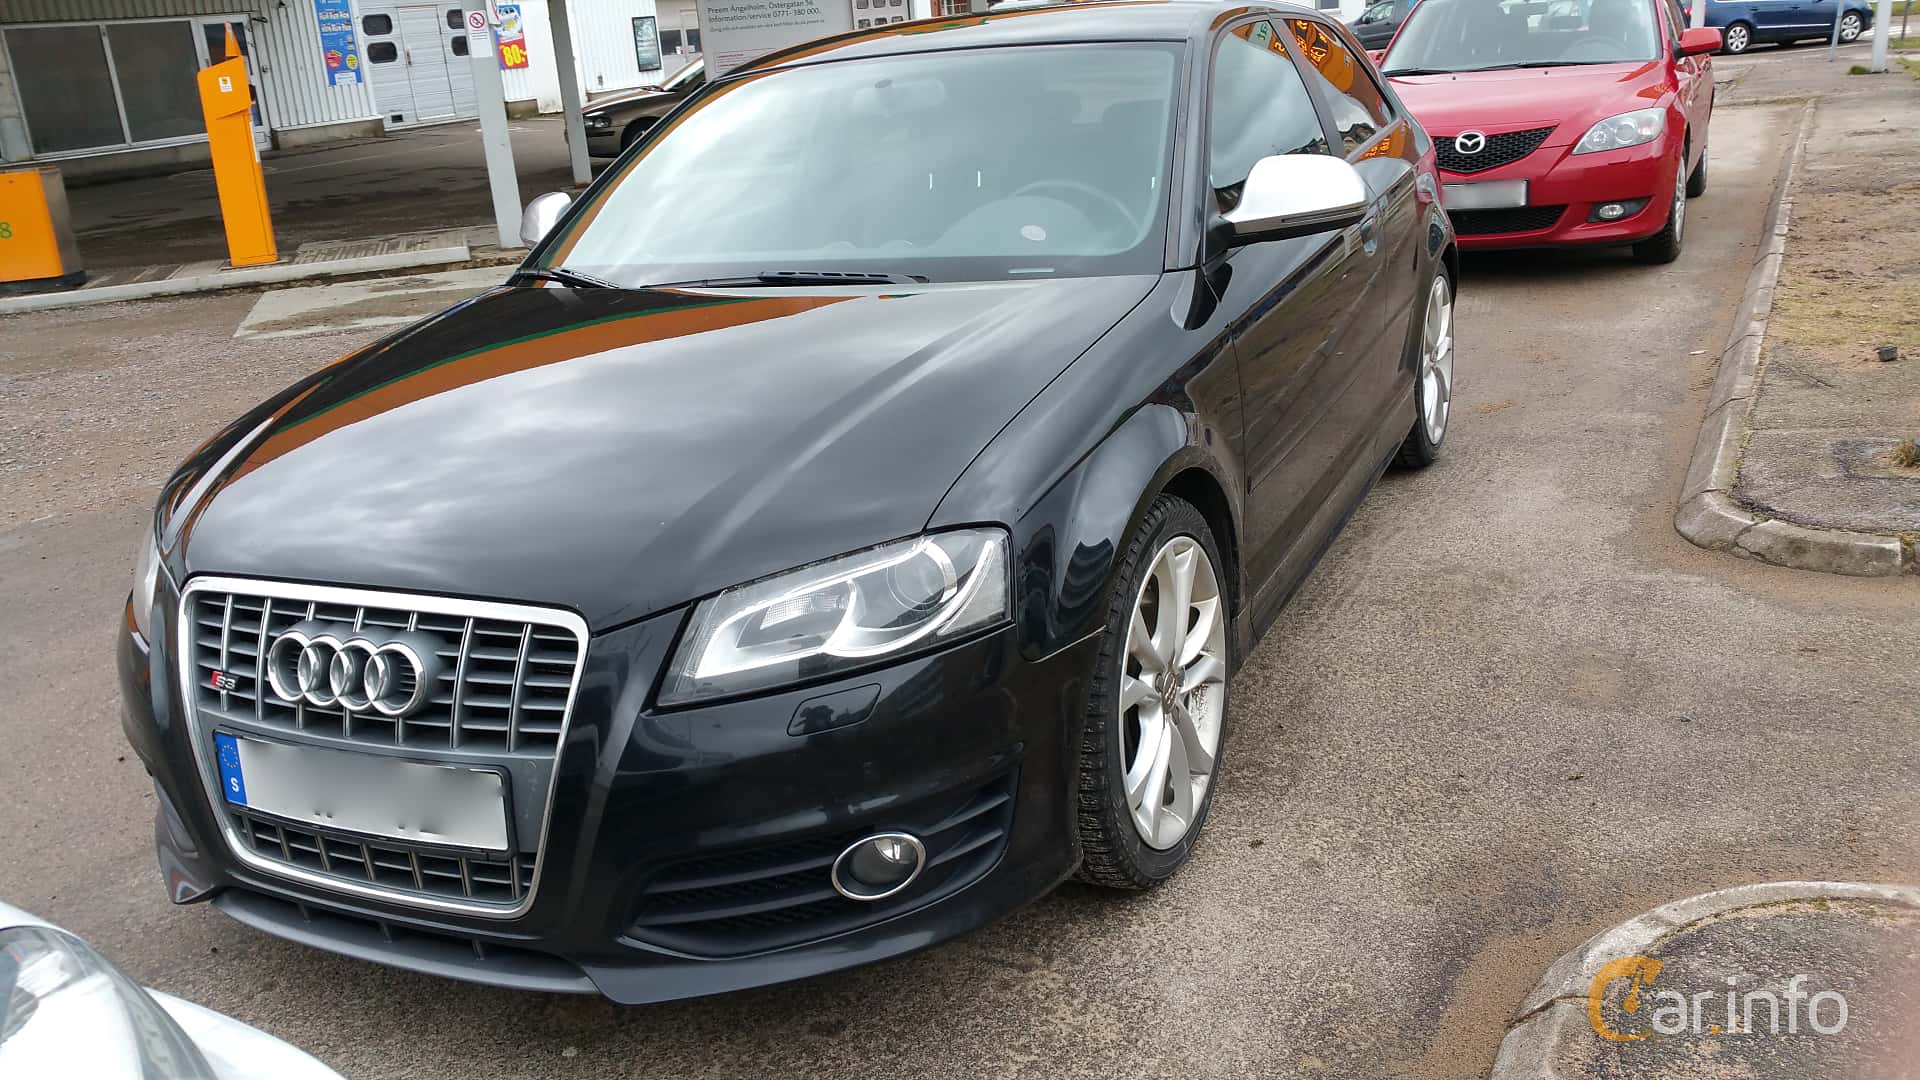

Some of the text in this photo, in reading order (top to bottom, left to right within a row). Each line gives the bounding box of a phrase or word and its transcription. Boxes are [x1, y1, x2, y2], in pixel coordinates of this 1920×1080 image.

[768, 0, 806, 9] Östergatan
[215, 675, 236, 690] S3
[230, 777, 240, 792] S
